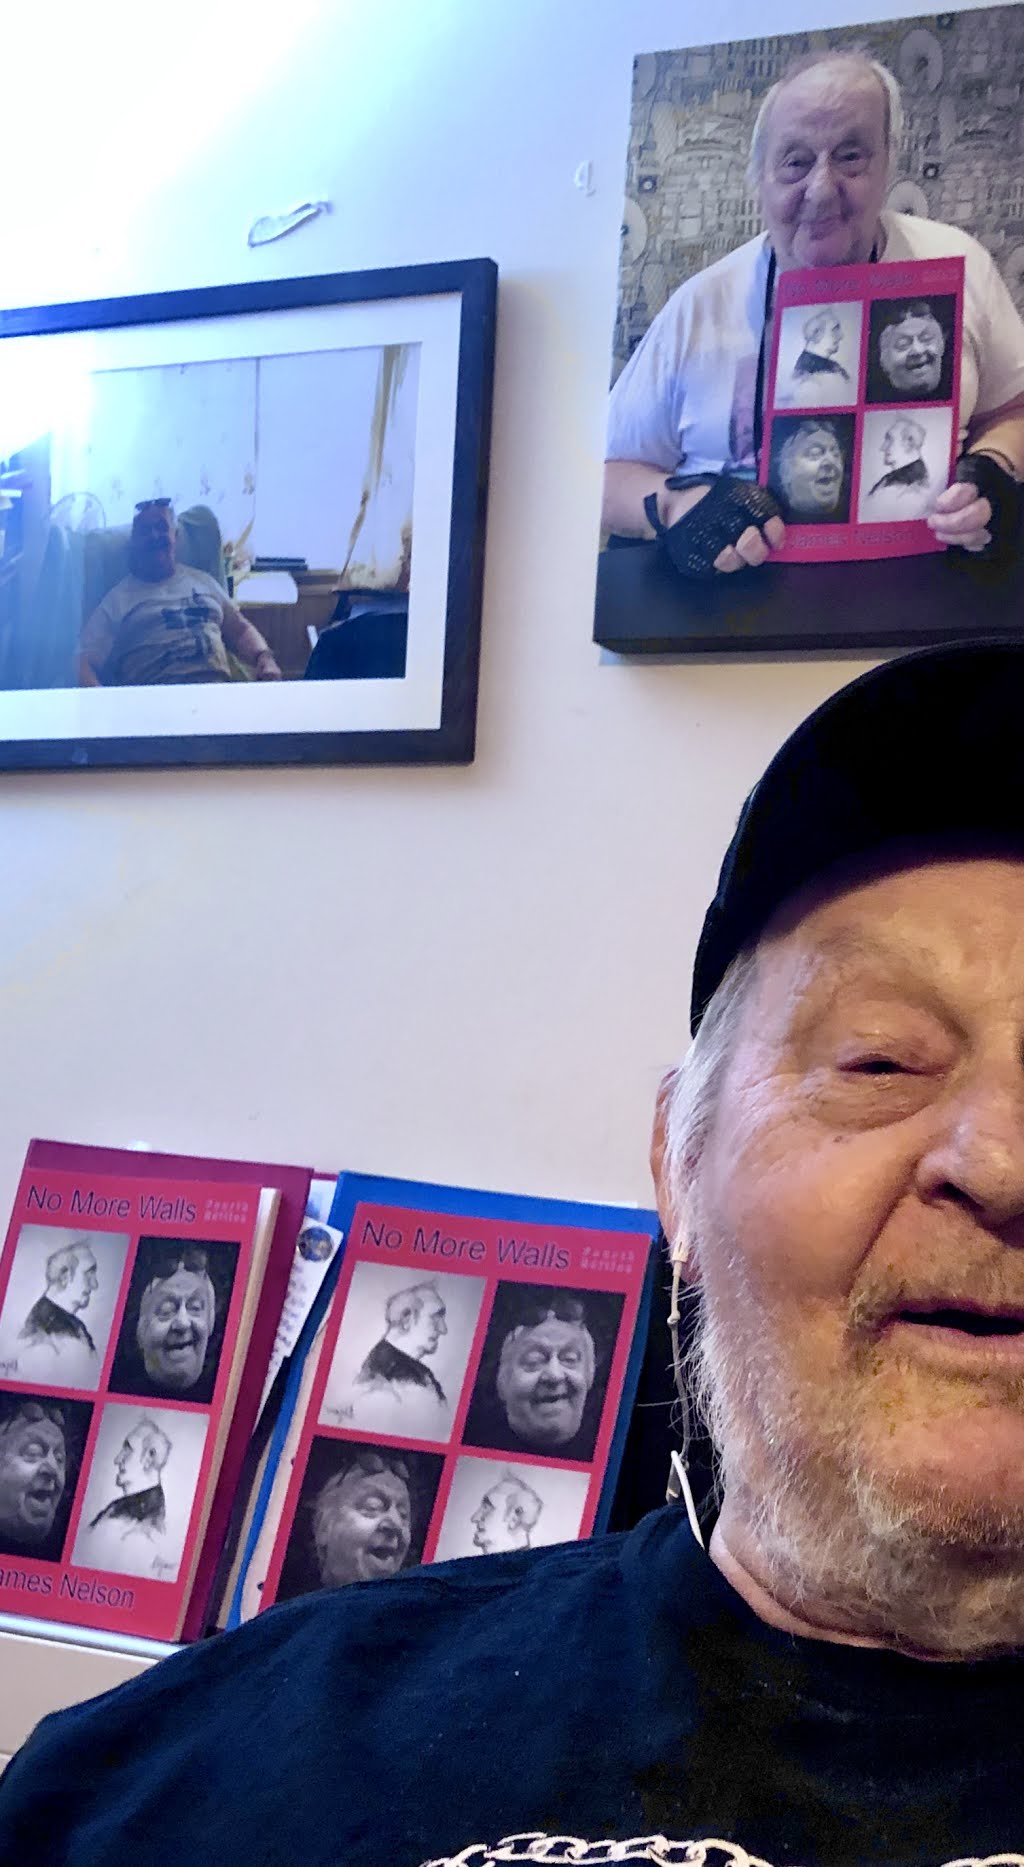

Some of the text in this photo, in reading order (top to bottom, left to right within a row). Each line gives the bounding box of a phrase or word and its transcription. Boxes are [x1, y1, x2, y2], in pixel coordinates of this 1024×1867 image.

[26, 1185, 197, 1223] No More Walls
[361, 1219, 570, 1270] No More Walls
[59, 1573, 135, 1609] Nelson
